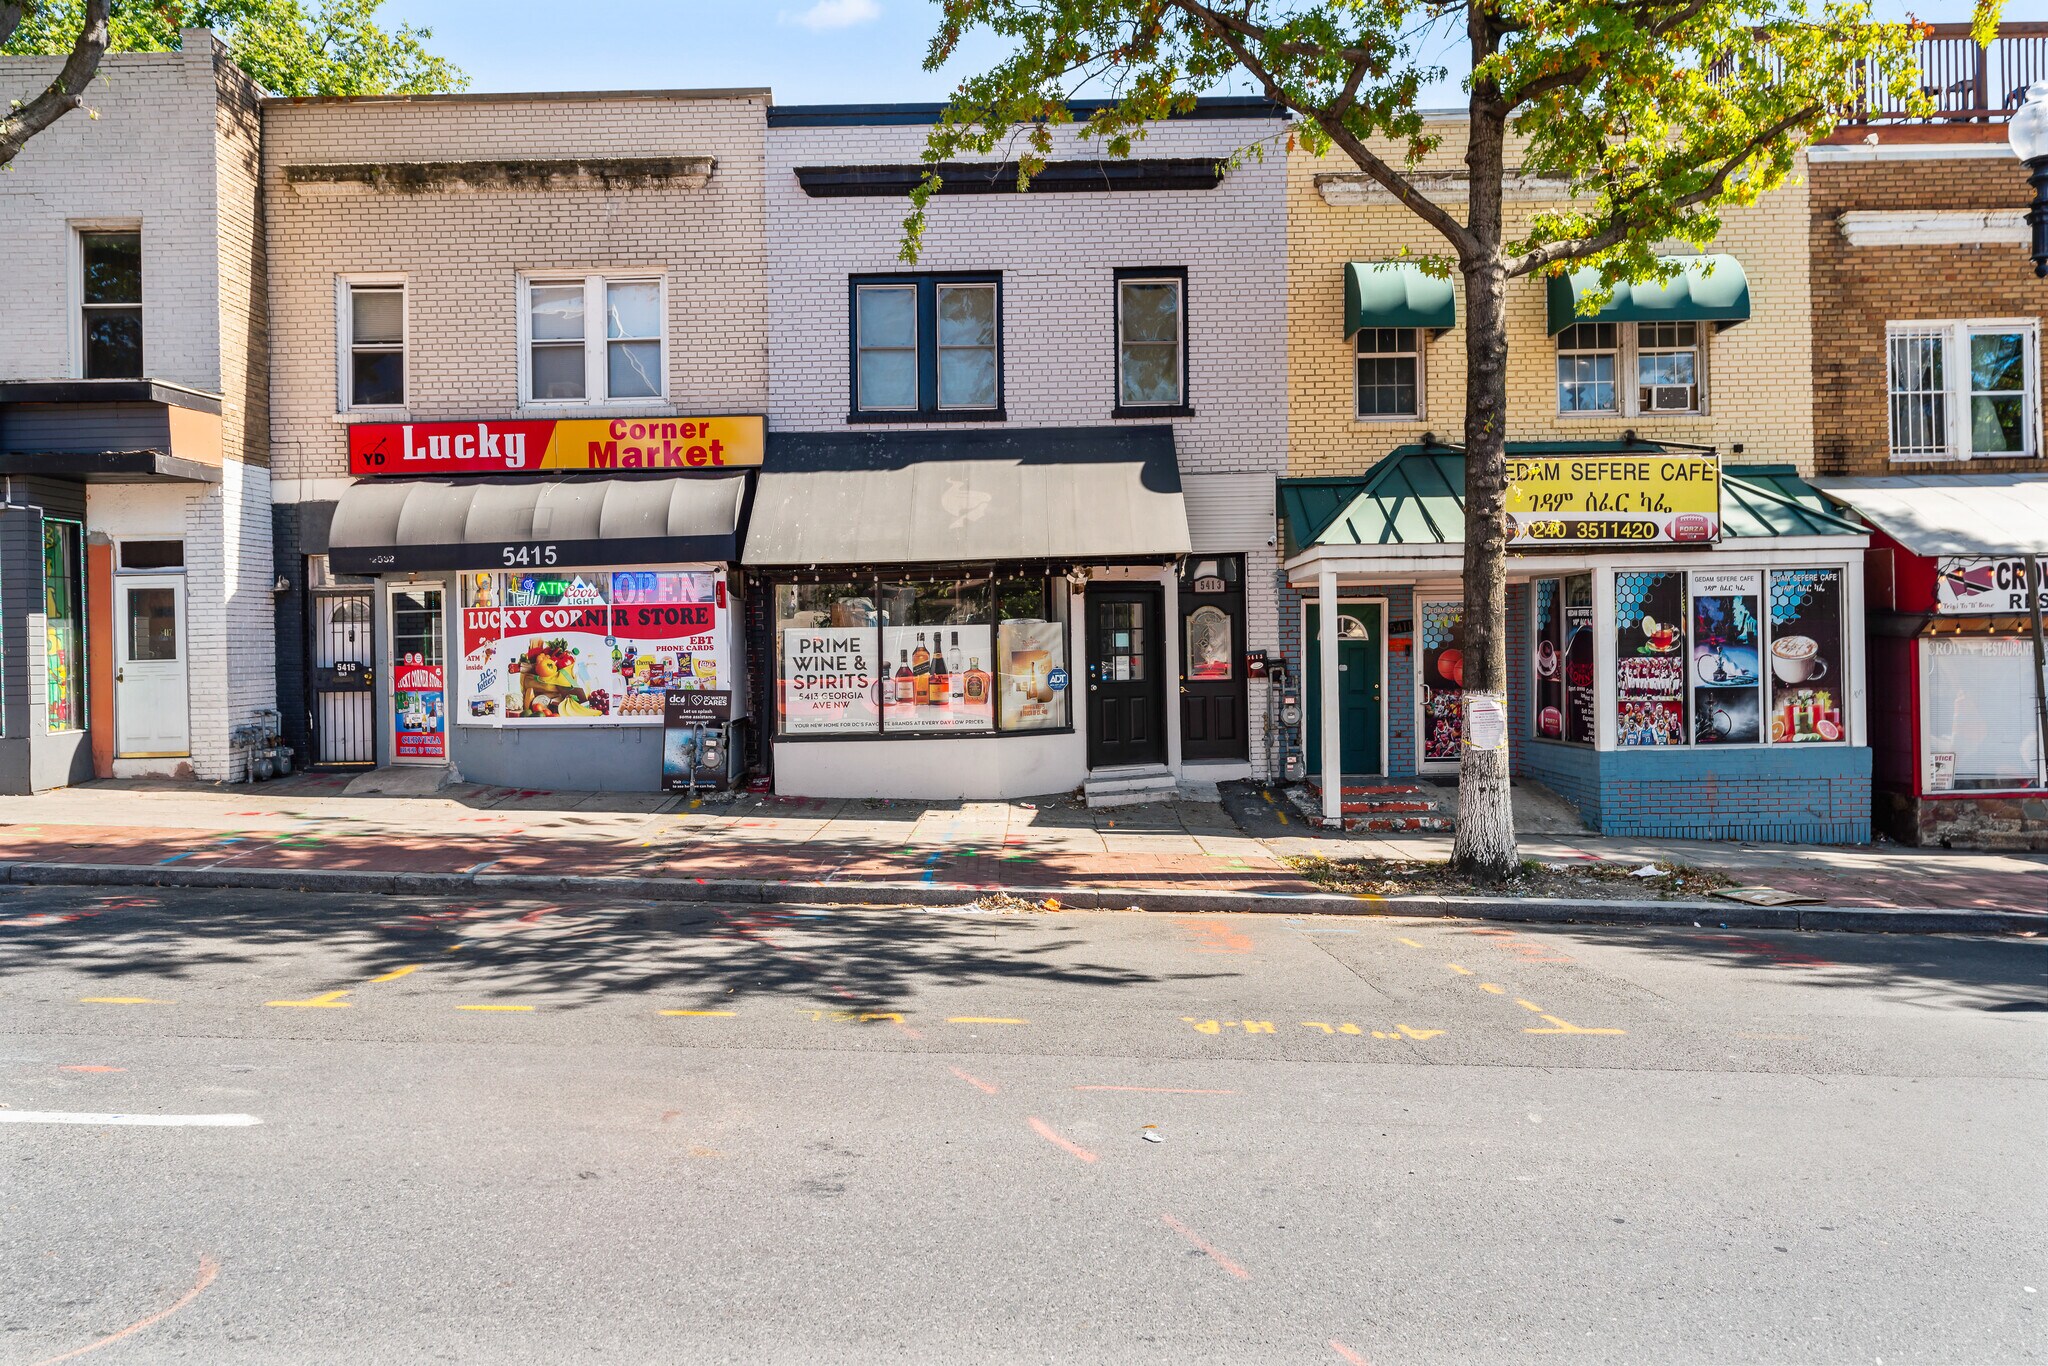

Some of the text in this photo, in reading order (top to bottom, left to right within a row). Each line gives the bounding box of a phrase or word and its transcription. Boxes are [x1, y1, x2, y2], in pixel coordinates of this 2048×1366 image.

[609, 419, 710, 441] Corner
[402, 423, 526, 468] Lucky
[363, 453, 386, 466] YD
[588, 439, 725, 469] Market
[1505, 462, 1714, 481] EDAM SEFERE CAFE
[1528, 492, 1574, 512] ገዳም
[1533, 521, 1655, 539] 240 3511420
[502, 545, 558, 566] 5415
[1200, 580, 1222, 590] 5413
[1793, 574, 1818, 582] SEFERE
[1820, 573, 1838, 581] CAFE
[537, 582, 569, 595] ATM
[564, 585, 599, 598] Coors
[614, 573, 698, 603] OPEN
[468, 606, 709, 630] LUCKY CORNER STORE
[689, 636, 714, 645] EBT
[800, 637, 861, 654] PRIME
[1981, 641, 2034, 657] RESTAURANT
[337, 663, 356, 671] 5415
[793, 655, 867, 671] WINE &
[398, 671, 410, 688] LUCKY
[793, 673, 869, 690] SPIRITS
[1049, 674, 1067, 684] ADT
[799, 691, 864, 700] 5413 GEORGIA
[812, 701, 850, 709] AVE NW
[401, 735, 441, 745] CERVEZA
[400, 746, 417, 754] BEER
[424, 746, 443, 755] WINE
